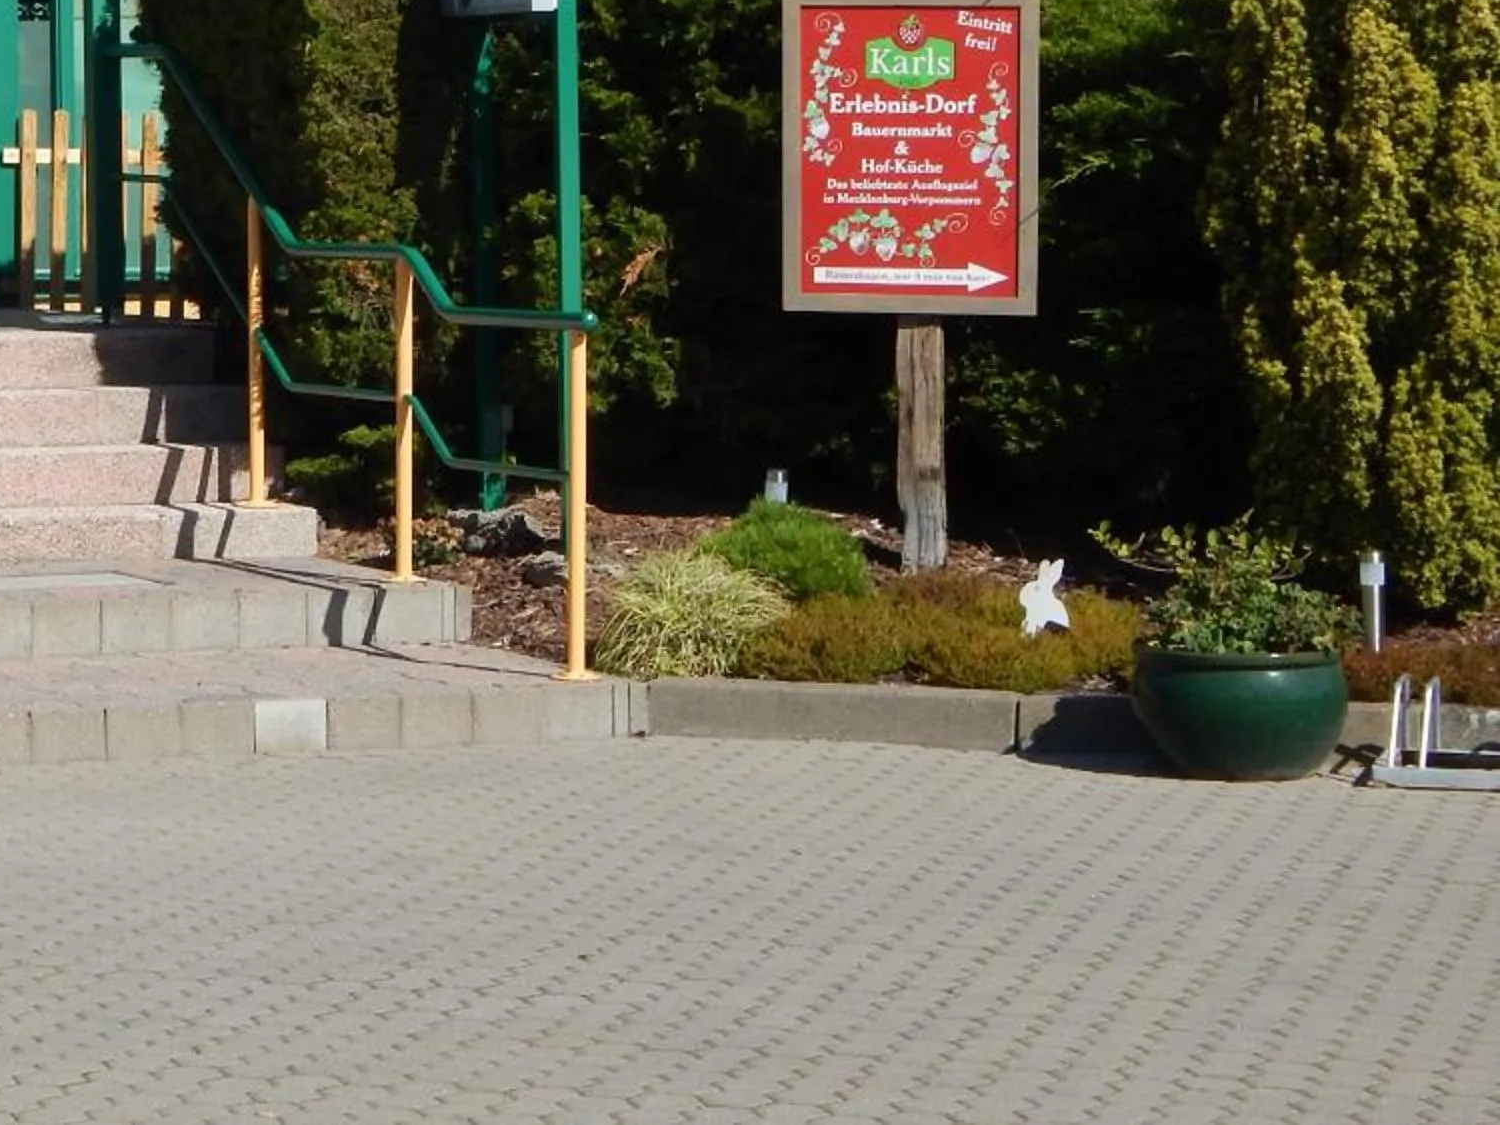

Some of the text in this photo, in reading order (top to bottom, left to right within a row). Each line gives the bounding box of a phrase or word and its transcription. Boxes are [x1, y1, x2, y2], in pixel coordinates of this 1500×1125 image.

[957, 10, 1013, 34] Eintritt
[964, 32, 997, 52] frei!
[869, 47, 950, 76] Karls
[829, 93, 978, 114] Erlebnis-Dorf
[852, 122, 953, 137] Bauernmarkt
[894, 140, 909, 156] &
[861, 158, 943, 174] Hof-Küche
[823, 193, 835, 204] in
